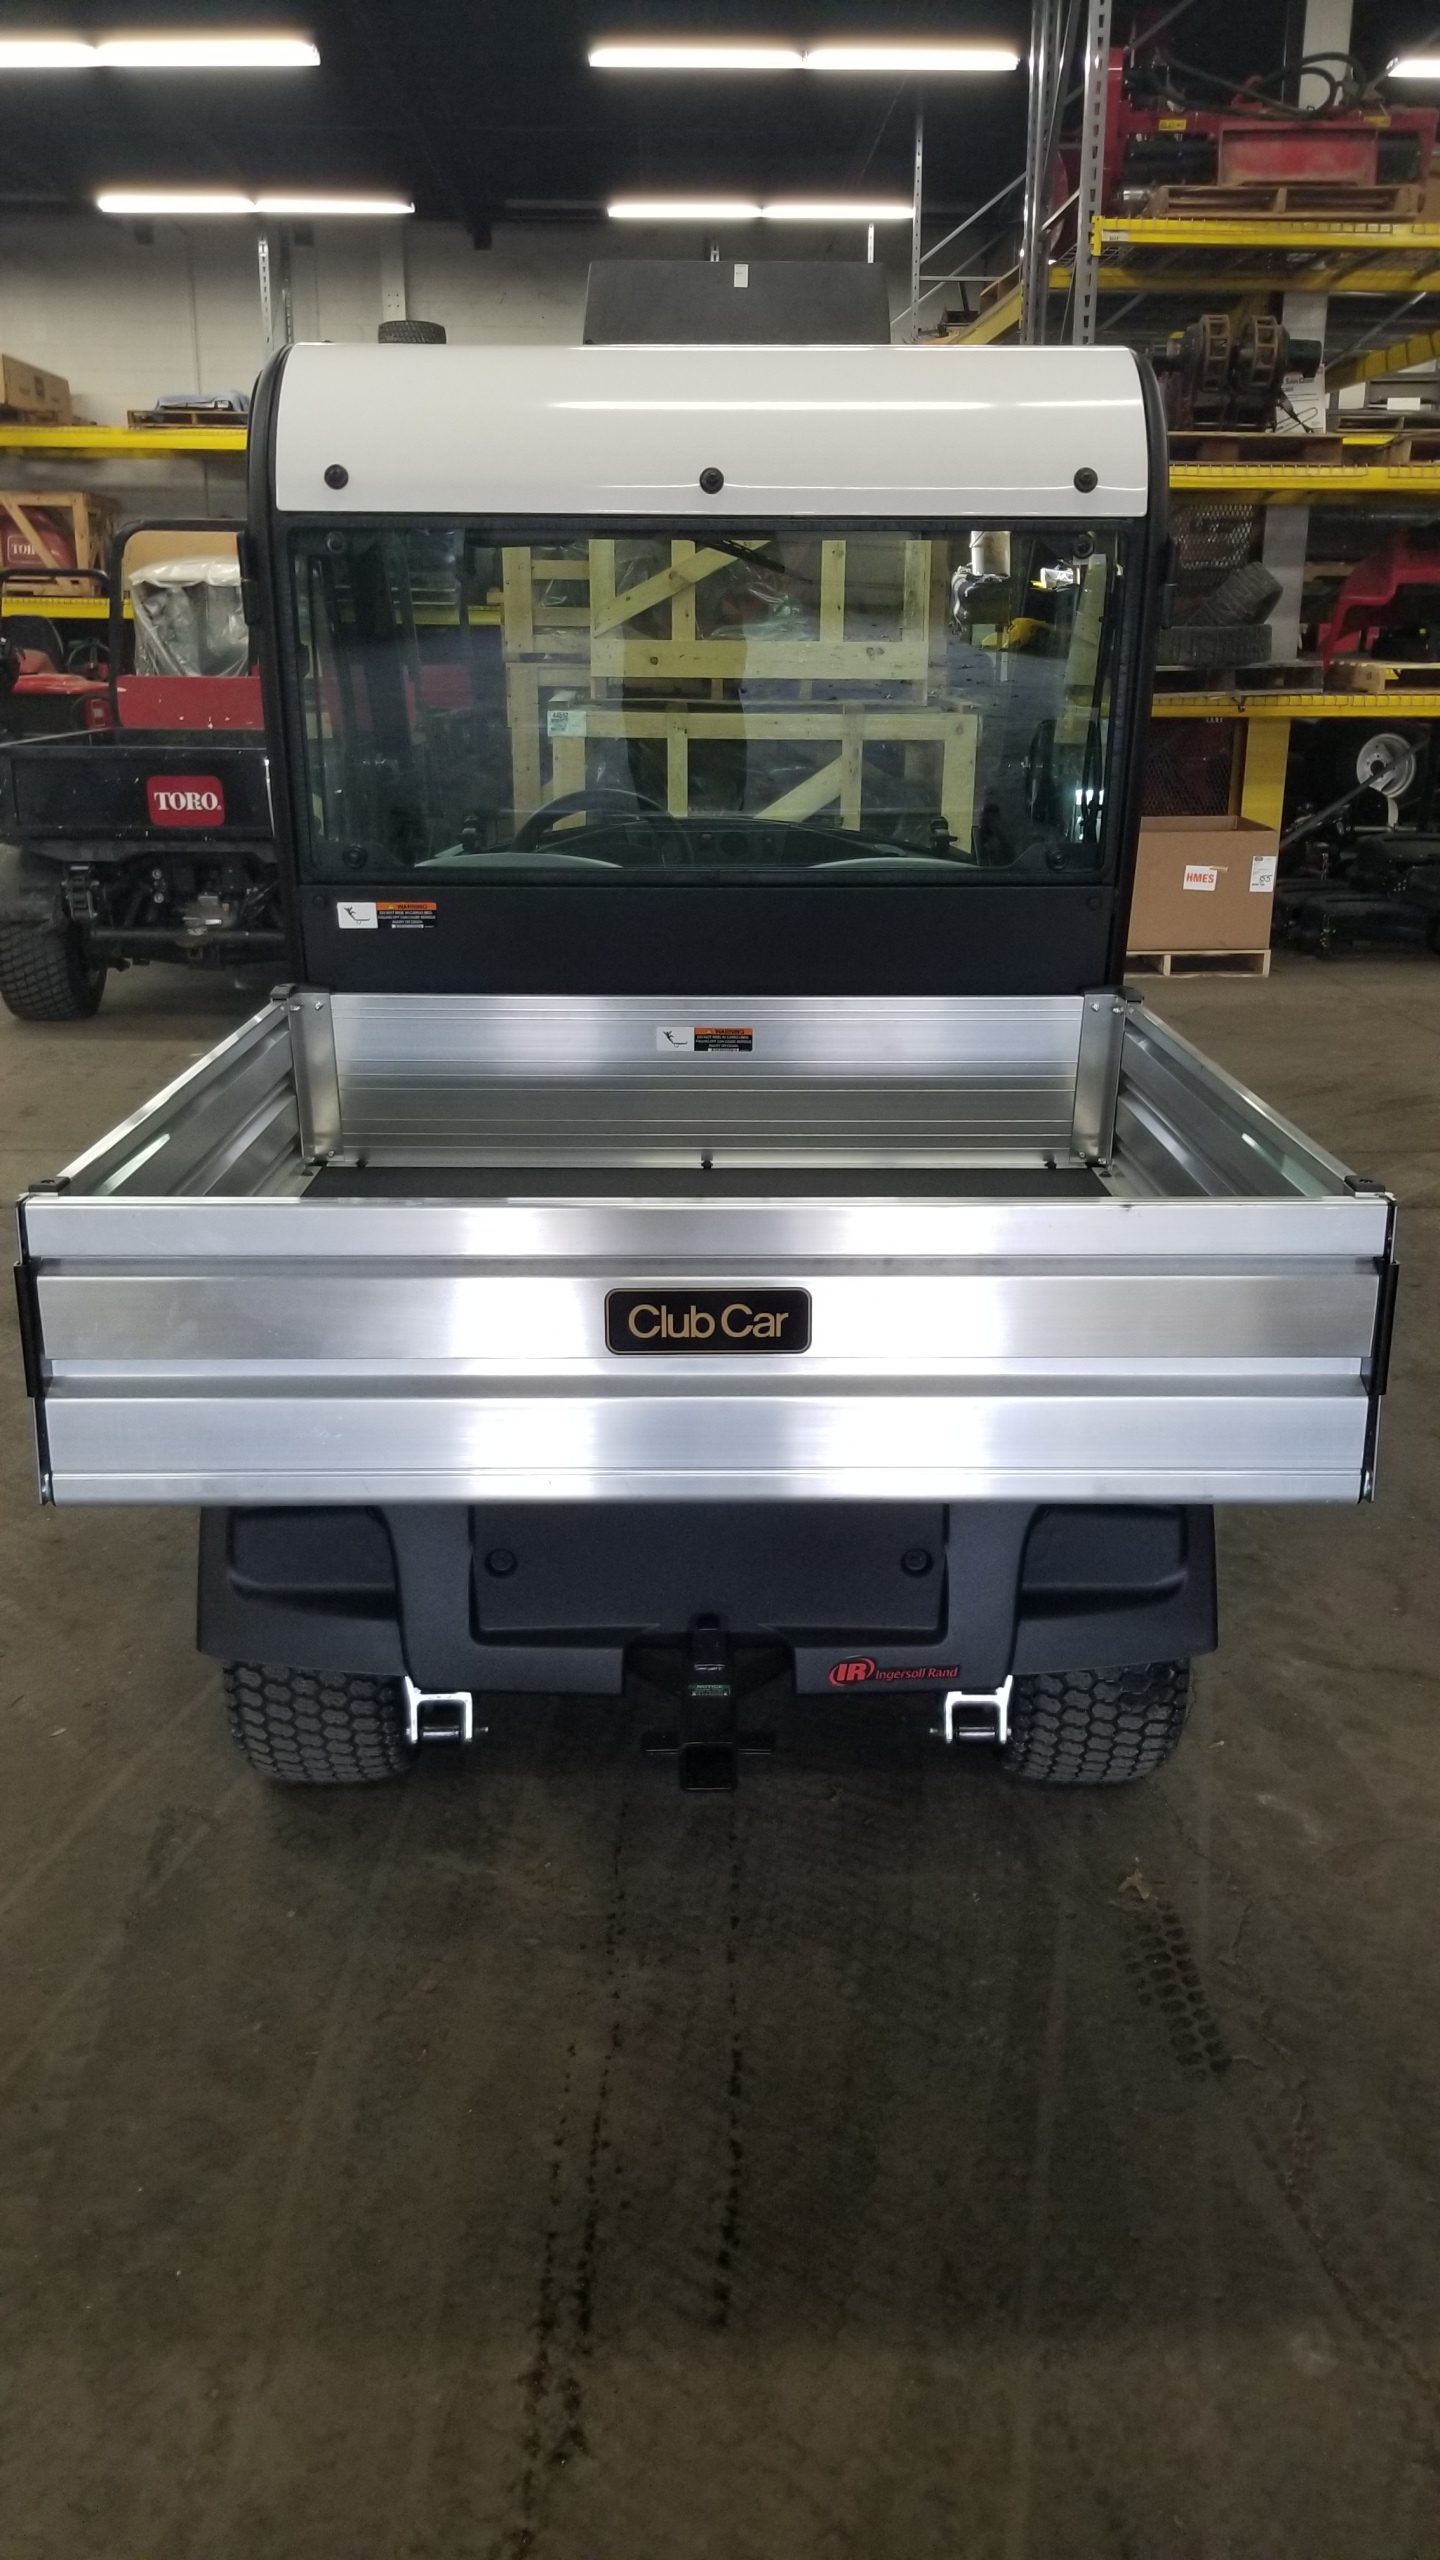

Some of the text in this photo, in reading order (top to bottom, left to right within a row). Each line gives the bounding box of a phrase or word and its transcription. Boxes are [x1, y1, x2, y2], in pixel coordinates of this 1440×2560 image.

[153, 791, 219, 811] TORO
[1186, 872, 1215, 884] HMES
[628, 1303, 789, 1339] Club Car
[836, 1662, 959, 1681] IR Ingersoll Rand
